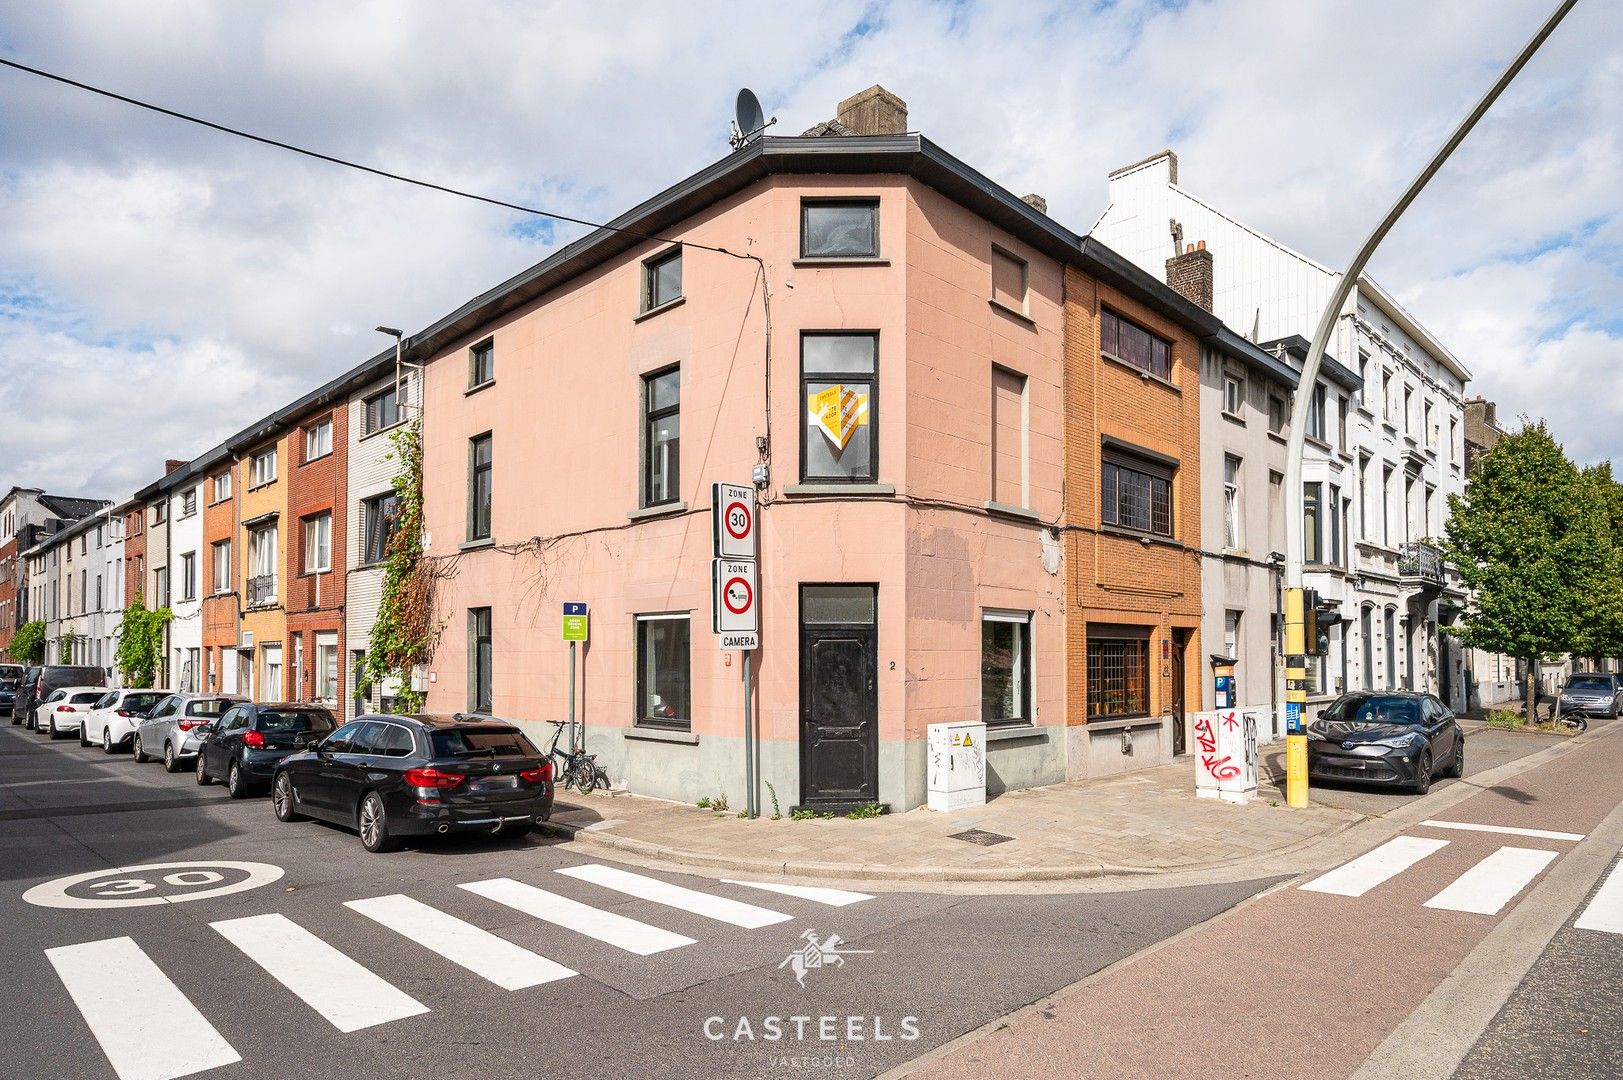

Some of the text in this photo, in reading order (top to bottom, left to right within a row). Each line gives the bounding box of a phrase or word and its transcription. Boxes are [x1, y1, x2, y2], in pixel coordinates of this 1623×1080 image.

[728, 489, 747, 499] ZONE
[731, 513, 746, 528] 30
[727, 565, 748, 573] ZONE
[572, 605, 579, 613] P
[723, 637, 756, 647] CAMERA
[889, 660, 896, 671] 2
[89, 871, 225, 896] 30
